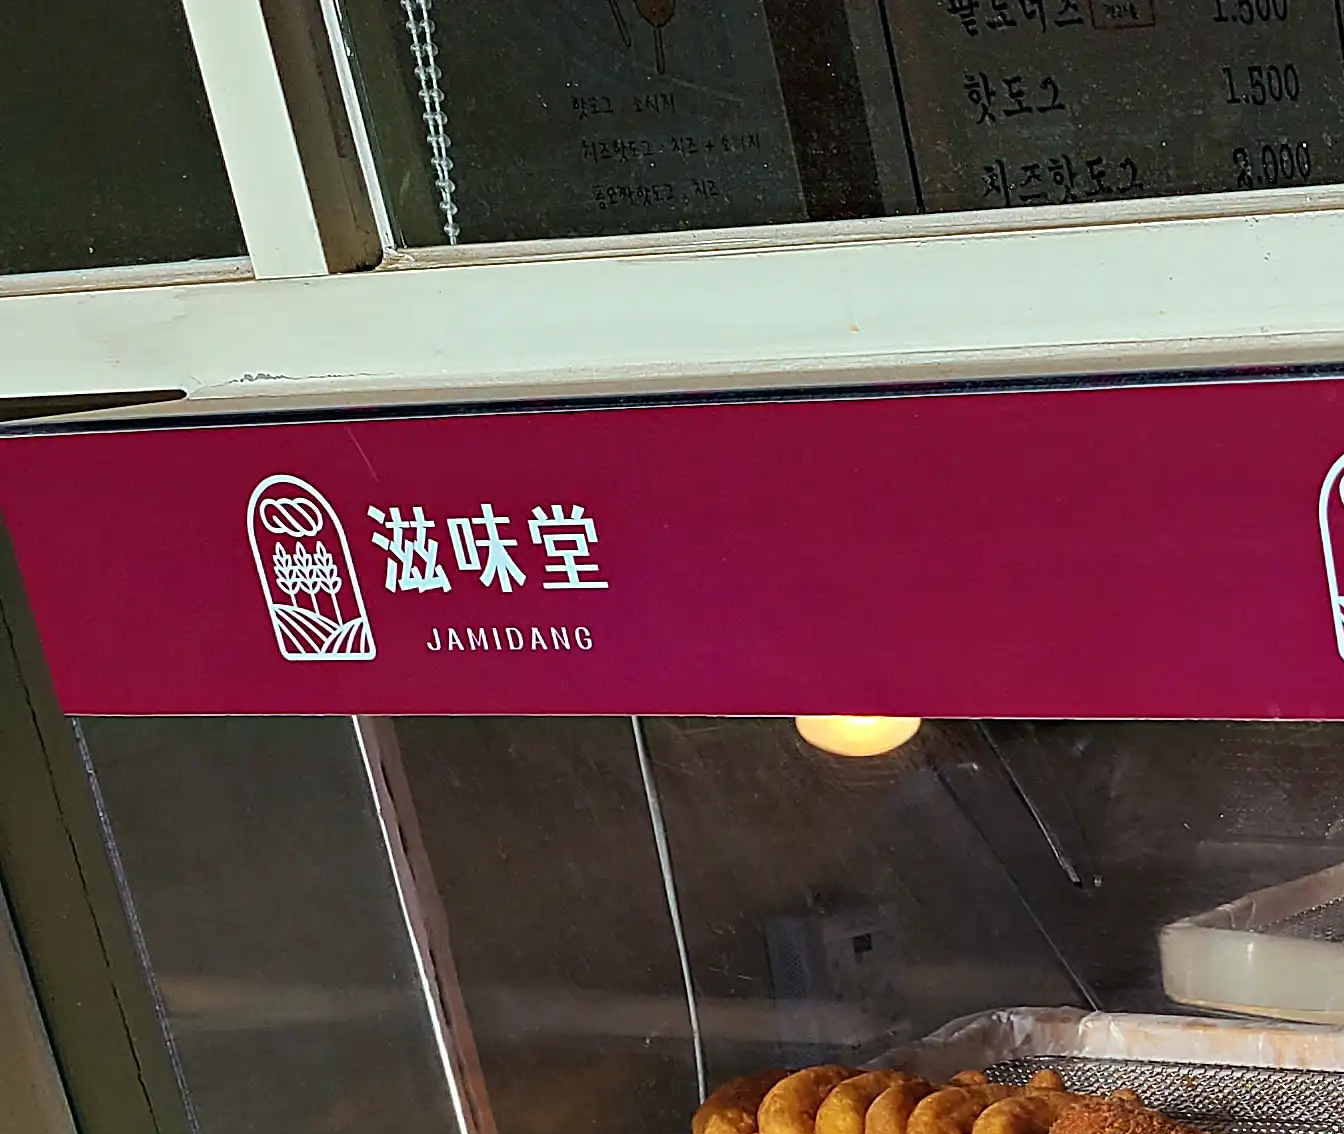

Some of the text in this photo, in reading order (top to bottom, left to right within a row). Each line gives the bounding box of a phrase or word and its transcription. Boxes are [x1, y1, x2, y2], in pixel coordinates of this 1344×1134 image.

[964, 63, 1300, 124] 핫도그 1.500
[982, 154, 1144, 208] 치즈핫도그
[367, 503, 608, 592] 滋味堂
[427, 626, 593, 651] JAMIDANG
